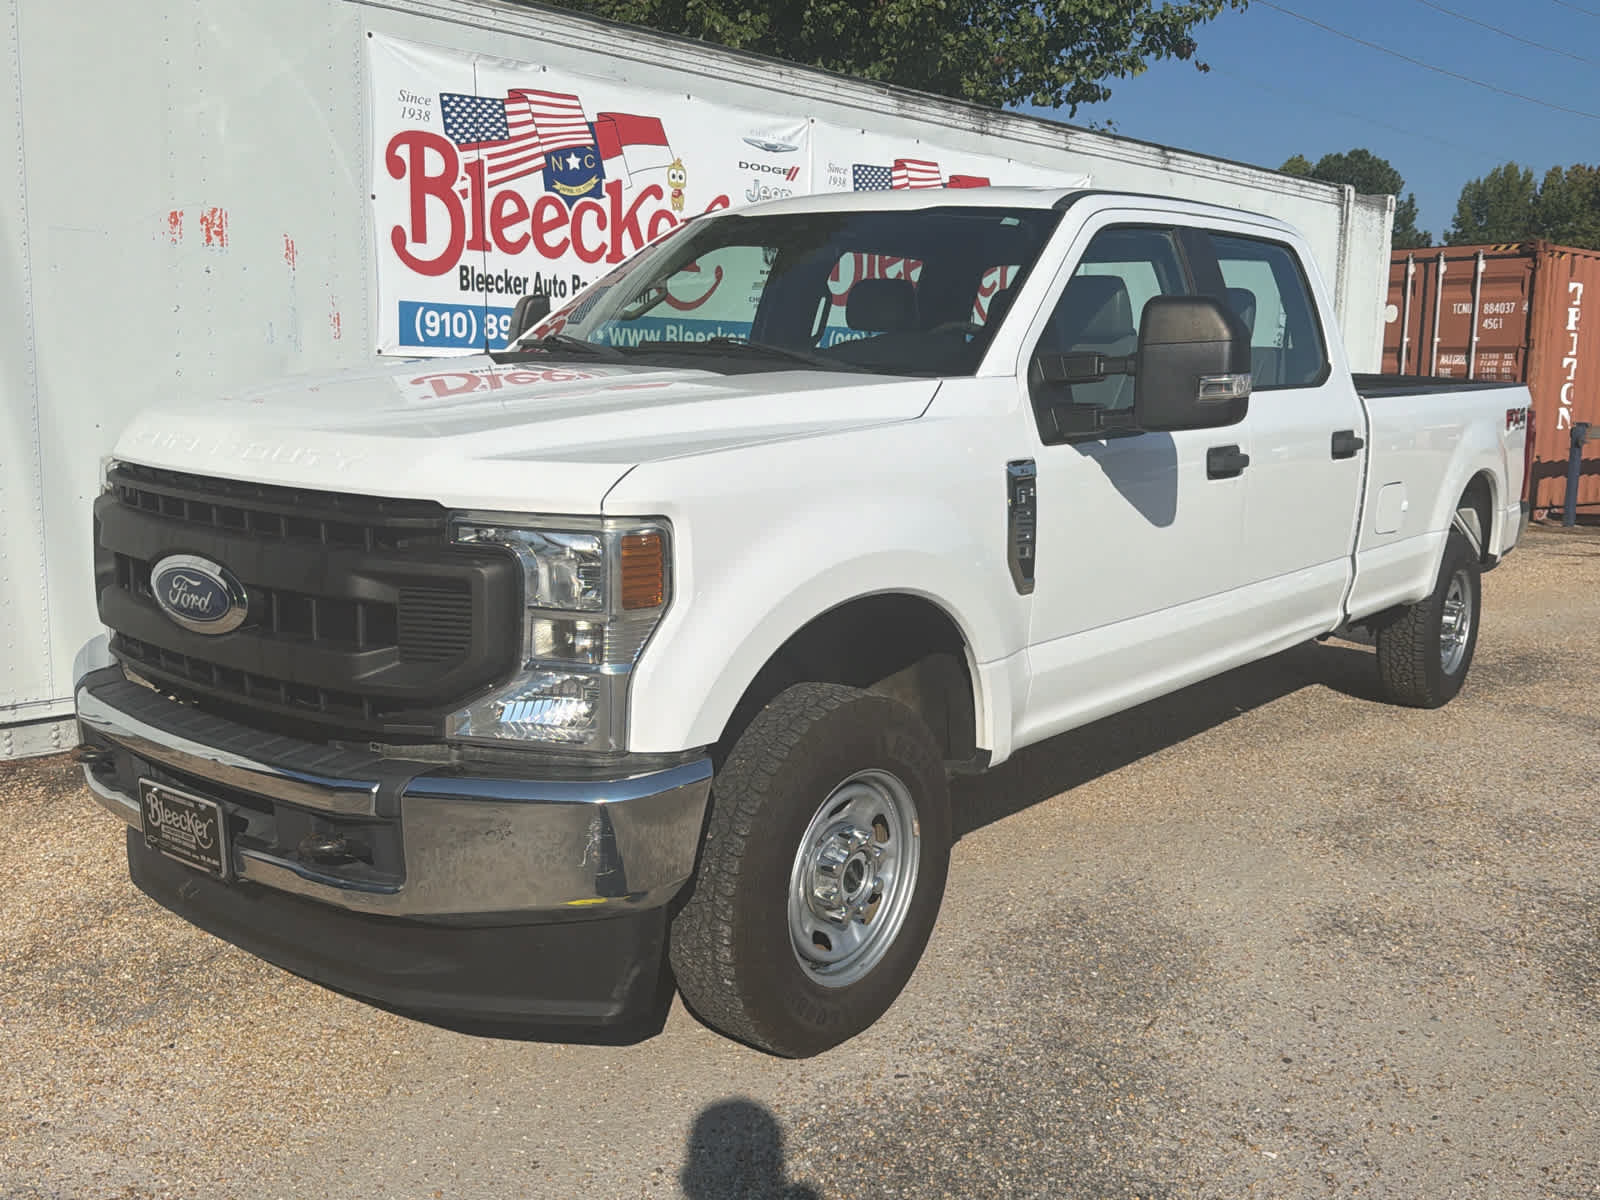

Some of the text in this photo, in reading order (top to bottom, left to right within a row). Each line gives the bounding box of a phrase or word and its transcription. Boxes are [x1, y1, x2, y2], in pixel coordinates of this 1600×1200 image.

[398, 89, 432, 106] Since
[401, 106, 431, 121] 1938
[551, 154, 596, 172] N C
[738, 160, 792, 177] DODGE
[827, 162, 848, 175] Since
[828, 175, 847, 187] 1938
[385, 130, 729, 276] Bleecke
[459, 264, 529, 296] Bleecker
[533, 271, 568, 299] Auto
[1453, 303, 1472, 315] TCNU
[1483, 302, 1516, 315] 884037
[415, 306, 477, 345] (910)
[1506, 408, 1526, 430] FX4
[168, 574, 212, 613] Ford
[145, 792, 214, 849] Bleecker
